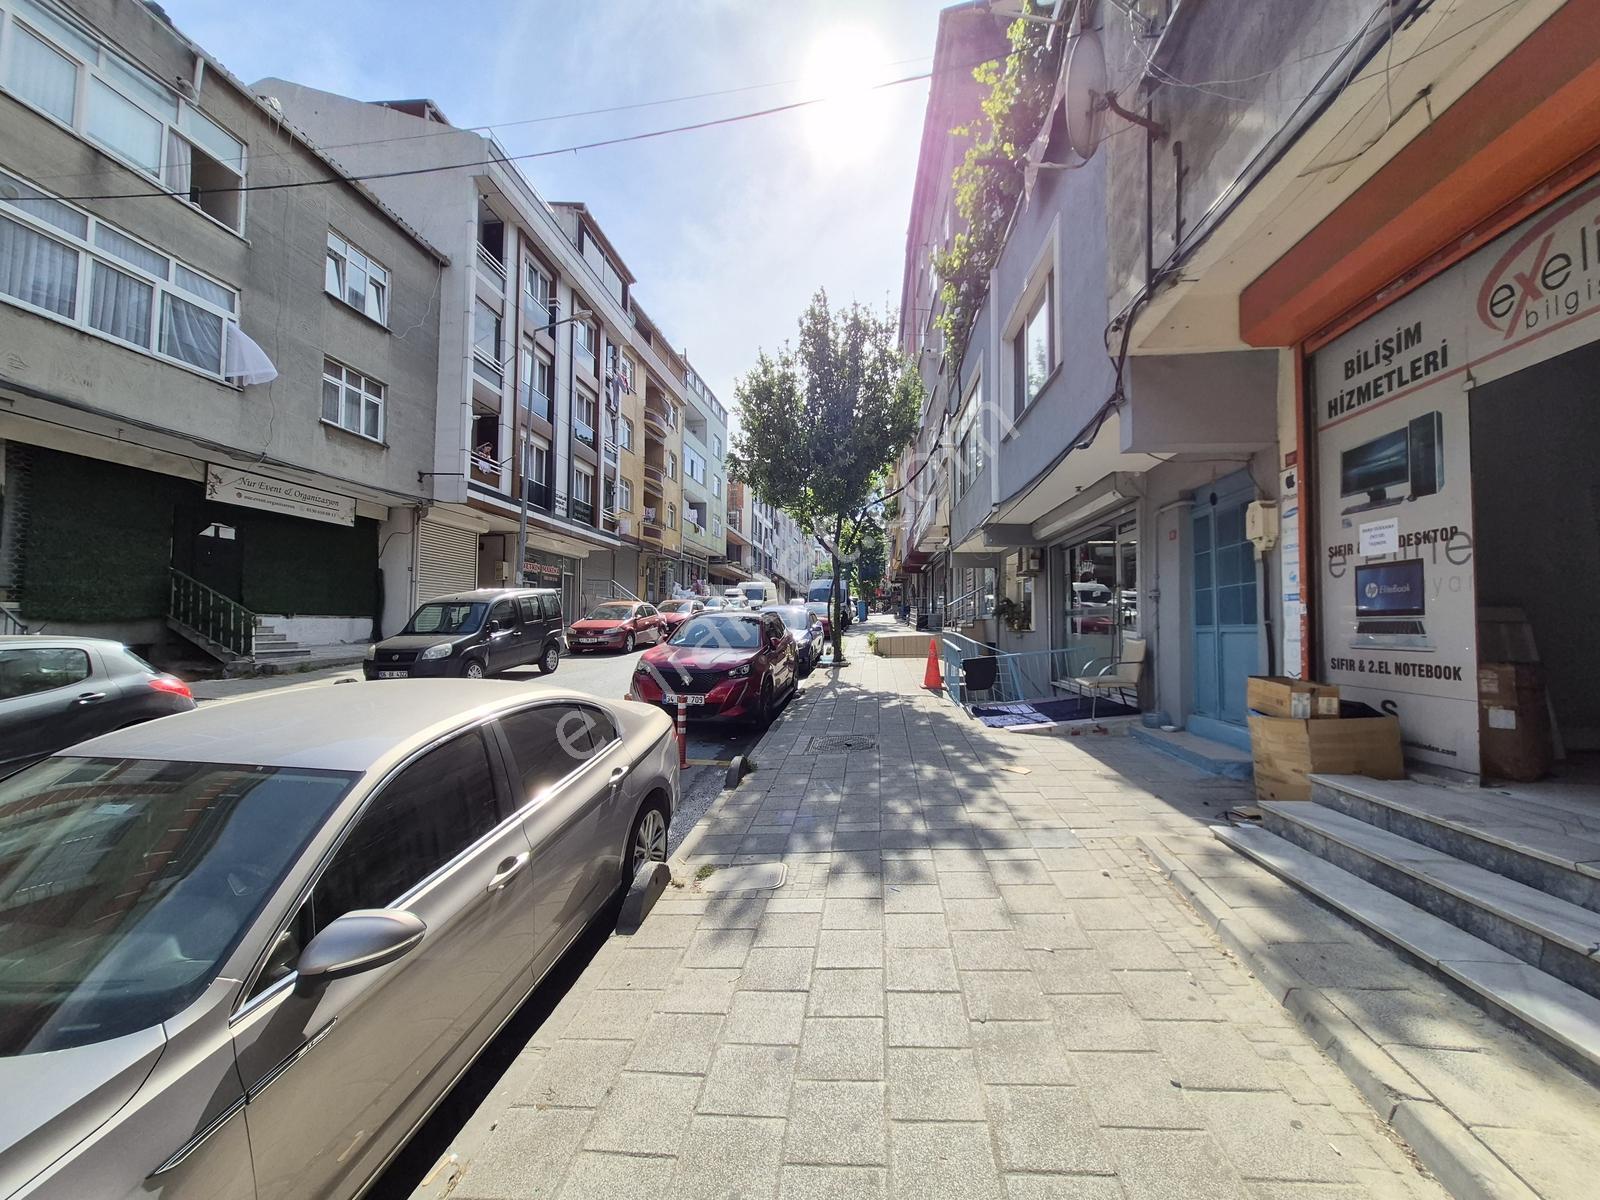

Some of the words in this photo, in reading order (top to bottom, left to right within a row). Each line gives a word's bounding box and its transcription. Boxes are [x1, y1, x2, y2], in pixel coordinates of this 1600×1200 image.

[1525, 279, 1600, 330] bilgi
[1344, 321, 1422, 381] BİLİŞİM
[1327, 339, 1448, 419] HİZMETLERİ
[239, 477, 257, 489] Nur
[258, 481, 282, 494] Event
[294, 490, 340, 508] Organizasyon
[1398, 525, 1459, 548] DESKTOP
[1331, 657, 1356, 672] SIFIR
[1358, 660, 1366, 673] &
[1368, 661, 1391, 675] 2.EL
[1394, 662, 1463, 681] NOTEBOOK
